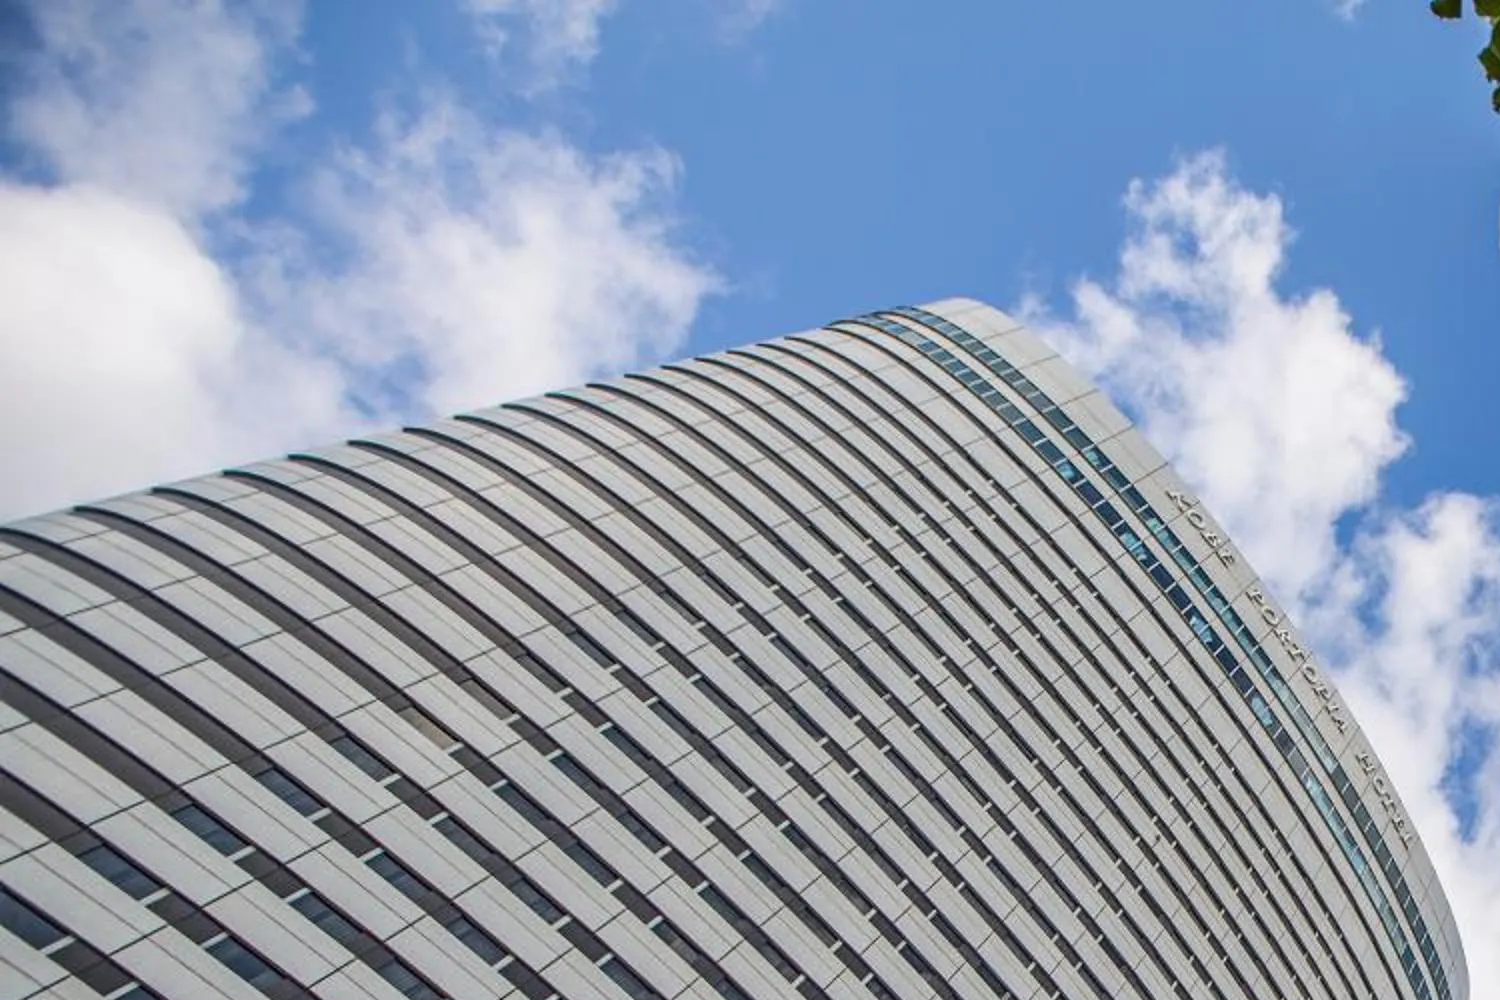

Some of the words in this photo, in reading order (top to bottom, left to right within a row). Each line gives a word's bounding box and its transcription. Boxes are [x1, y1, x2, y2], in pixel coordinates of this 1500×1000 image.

[1165, 490, 1235, 569] KOBE
[1246, 590, 1347, 734] PORTOPIA
[1355, 751, 1412, 851] HOTEL
